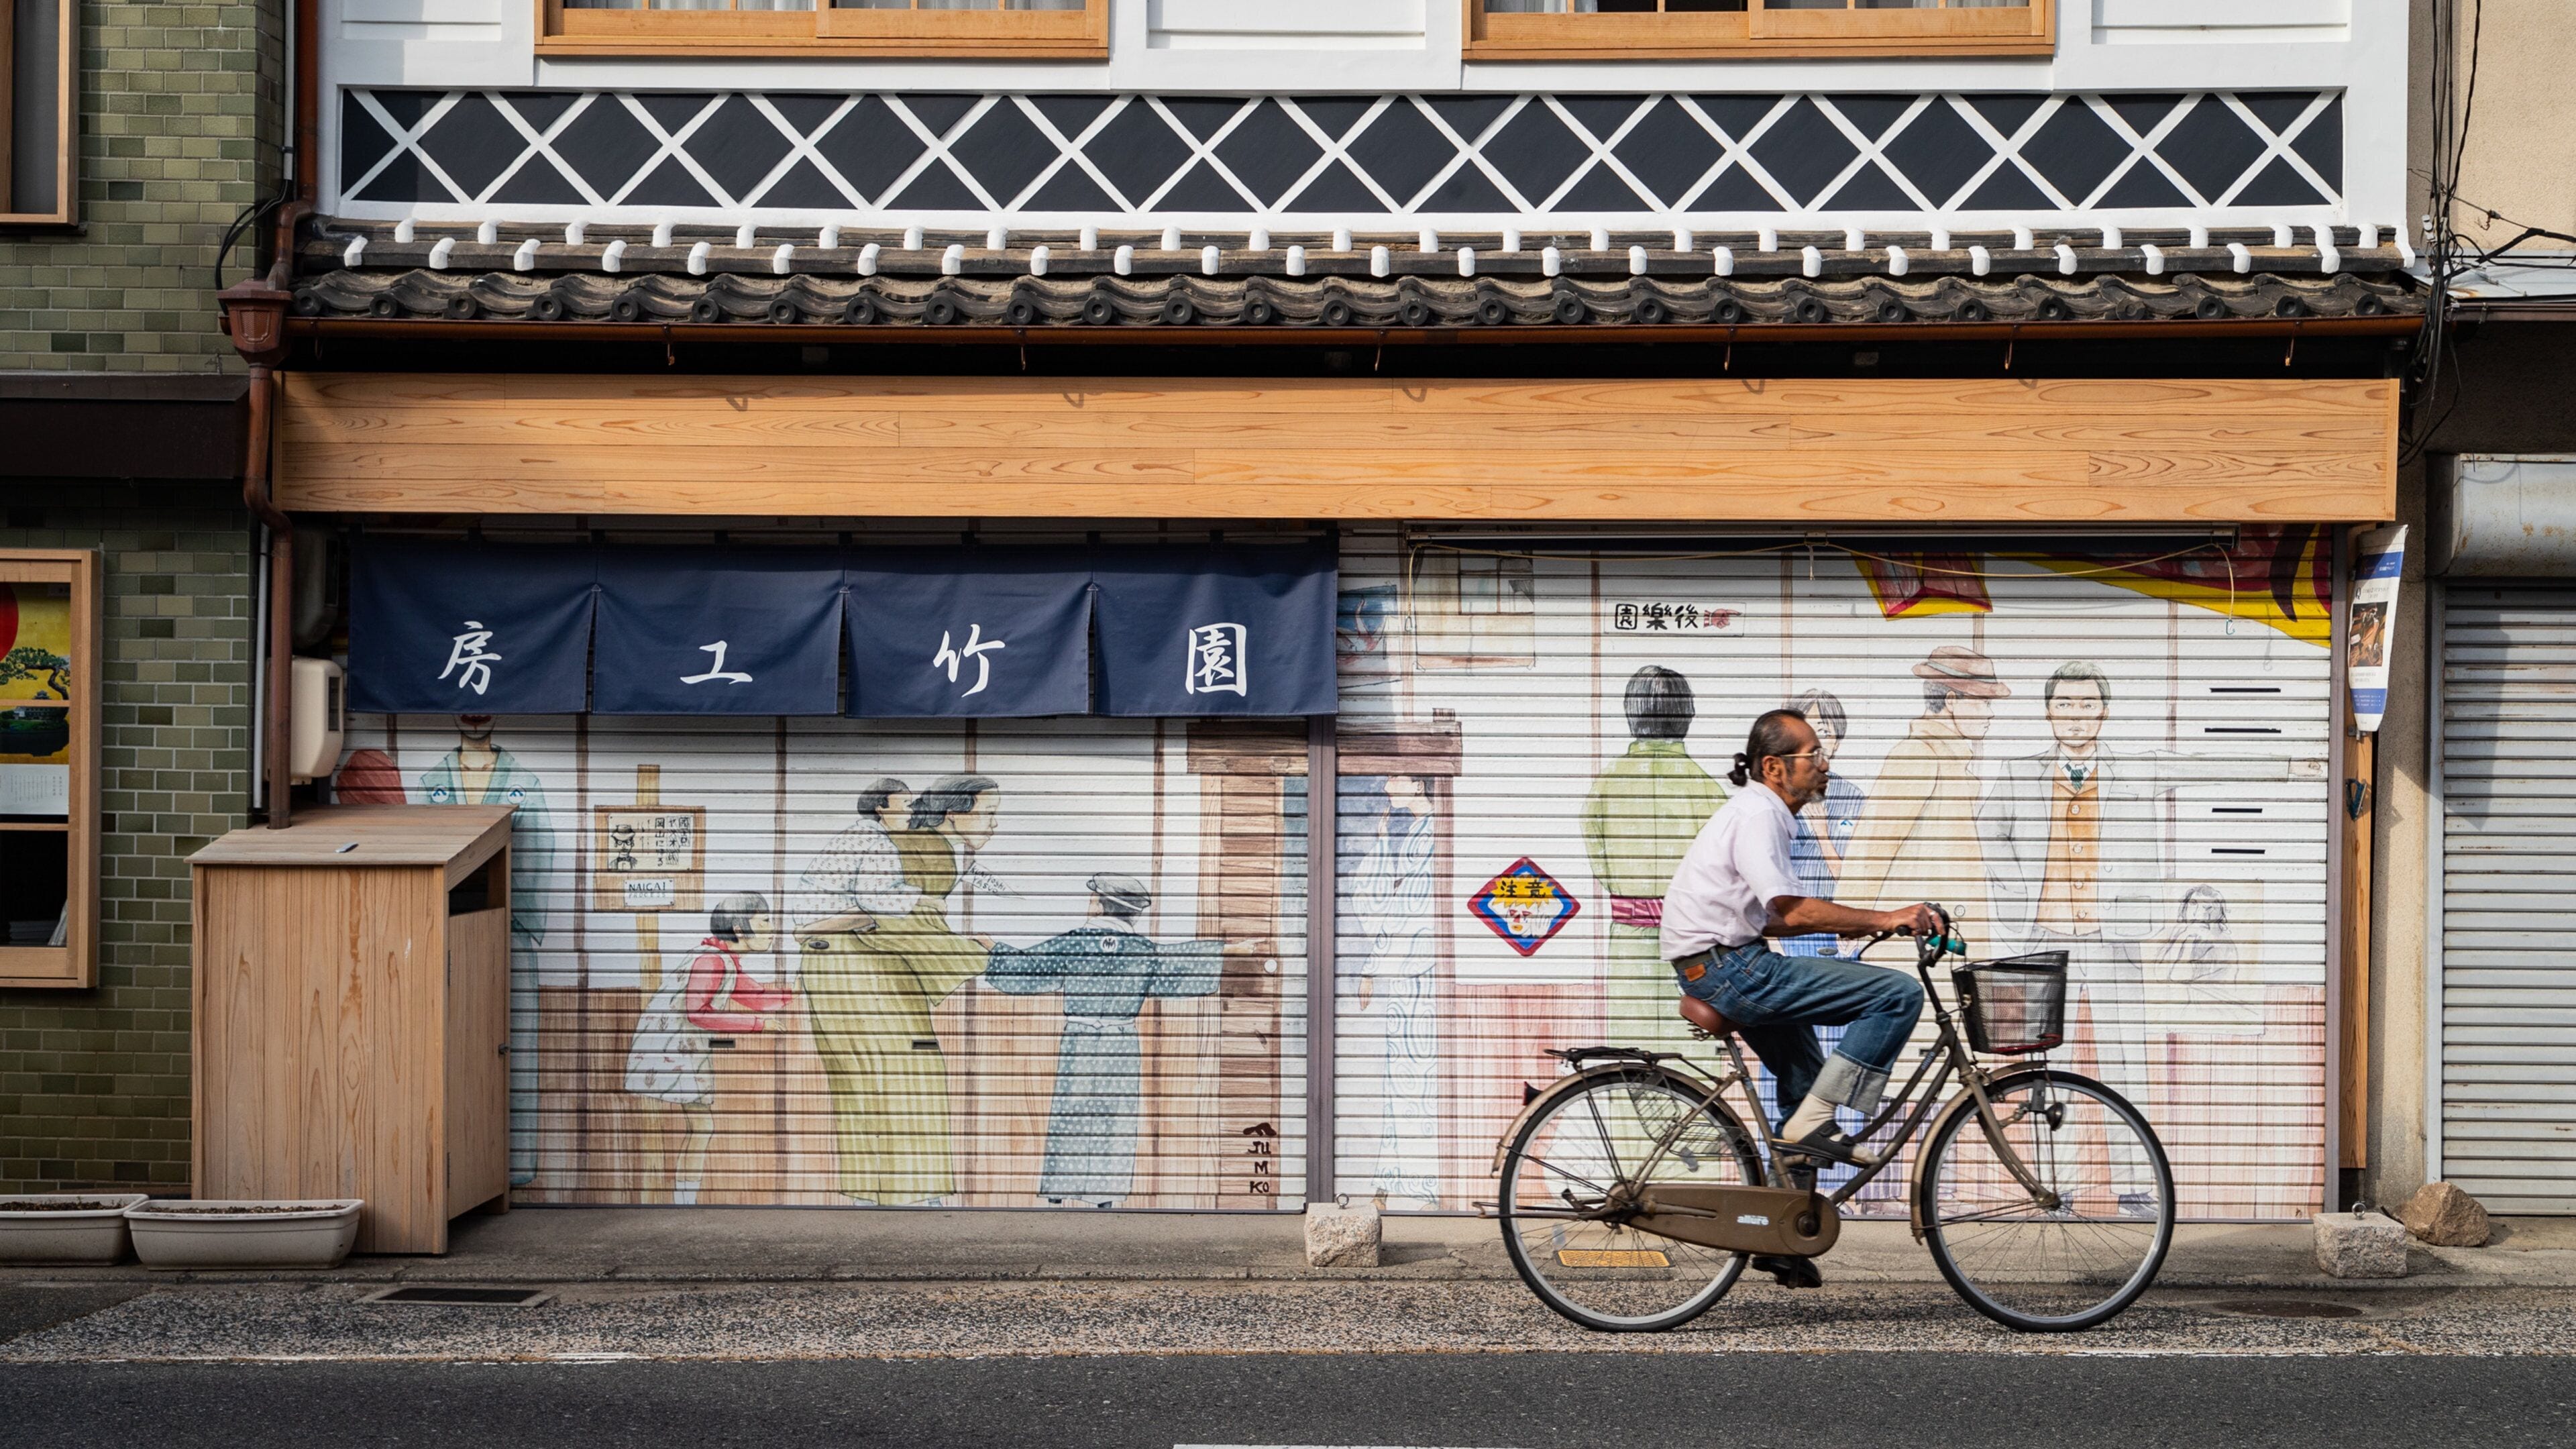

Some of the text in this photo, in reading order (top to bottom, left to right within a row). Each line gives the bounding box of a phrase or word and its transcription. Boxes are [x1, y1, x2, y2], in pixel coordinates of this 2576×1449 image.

[437, 621, 1247, 698] 園 竹 工 房
[1500, 879, 1547, 898] 注意
[1737, 1215, 1770, 1226] allure
